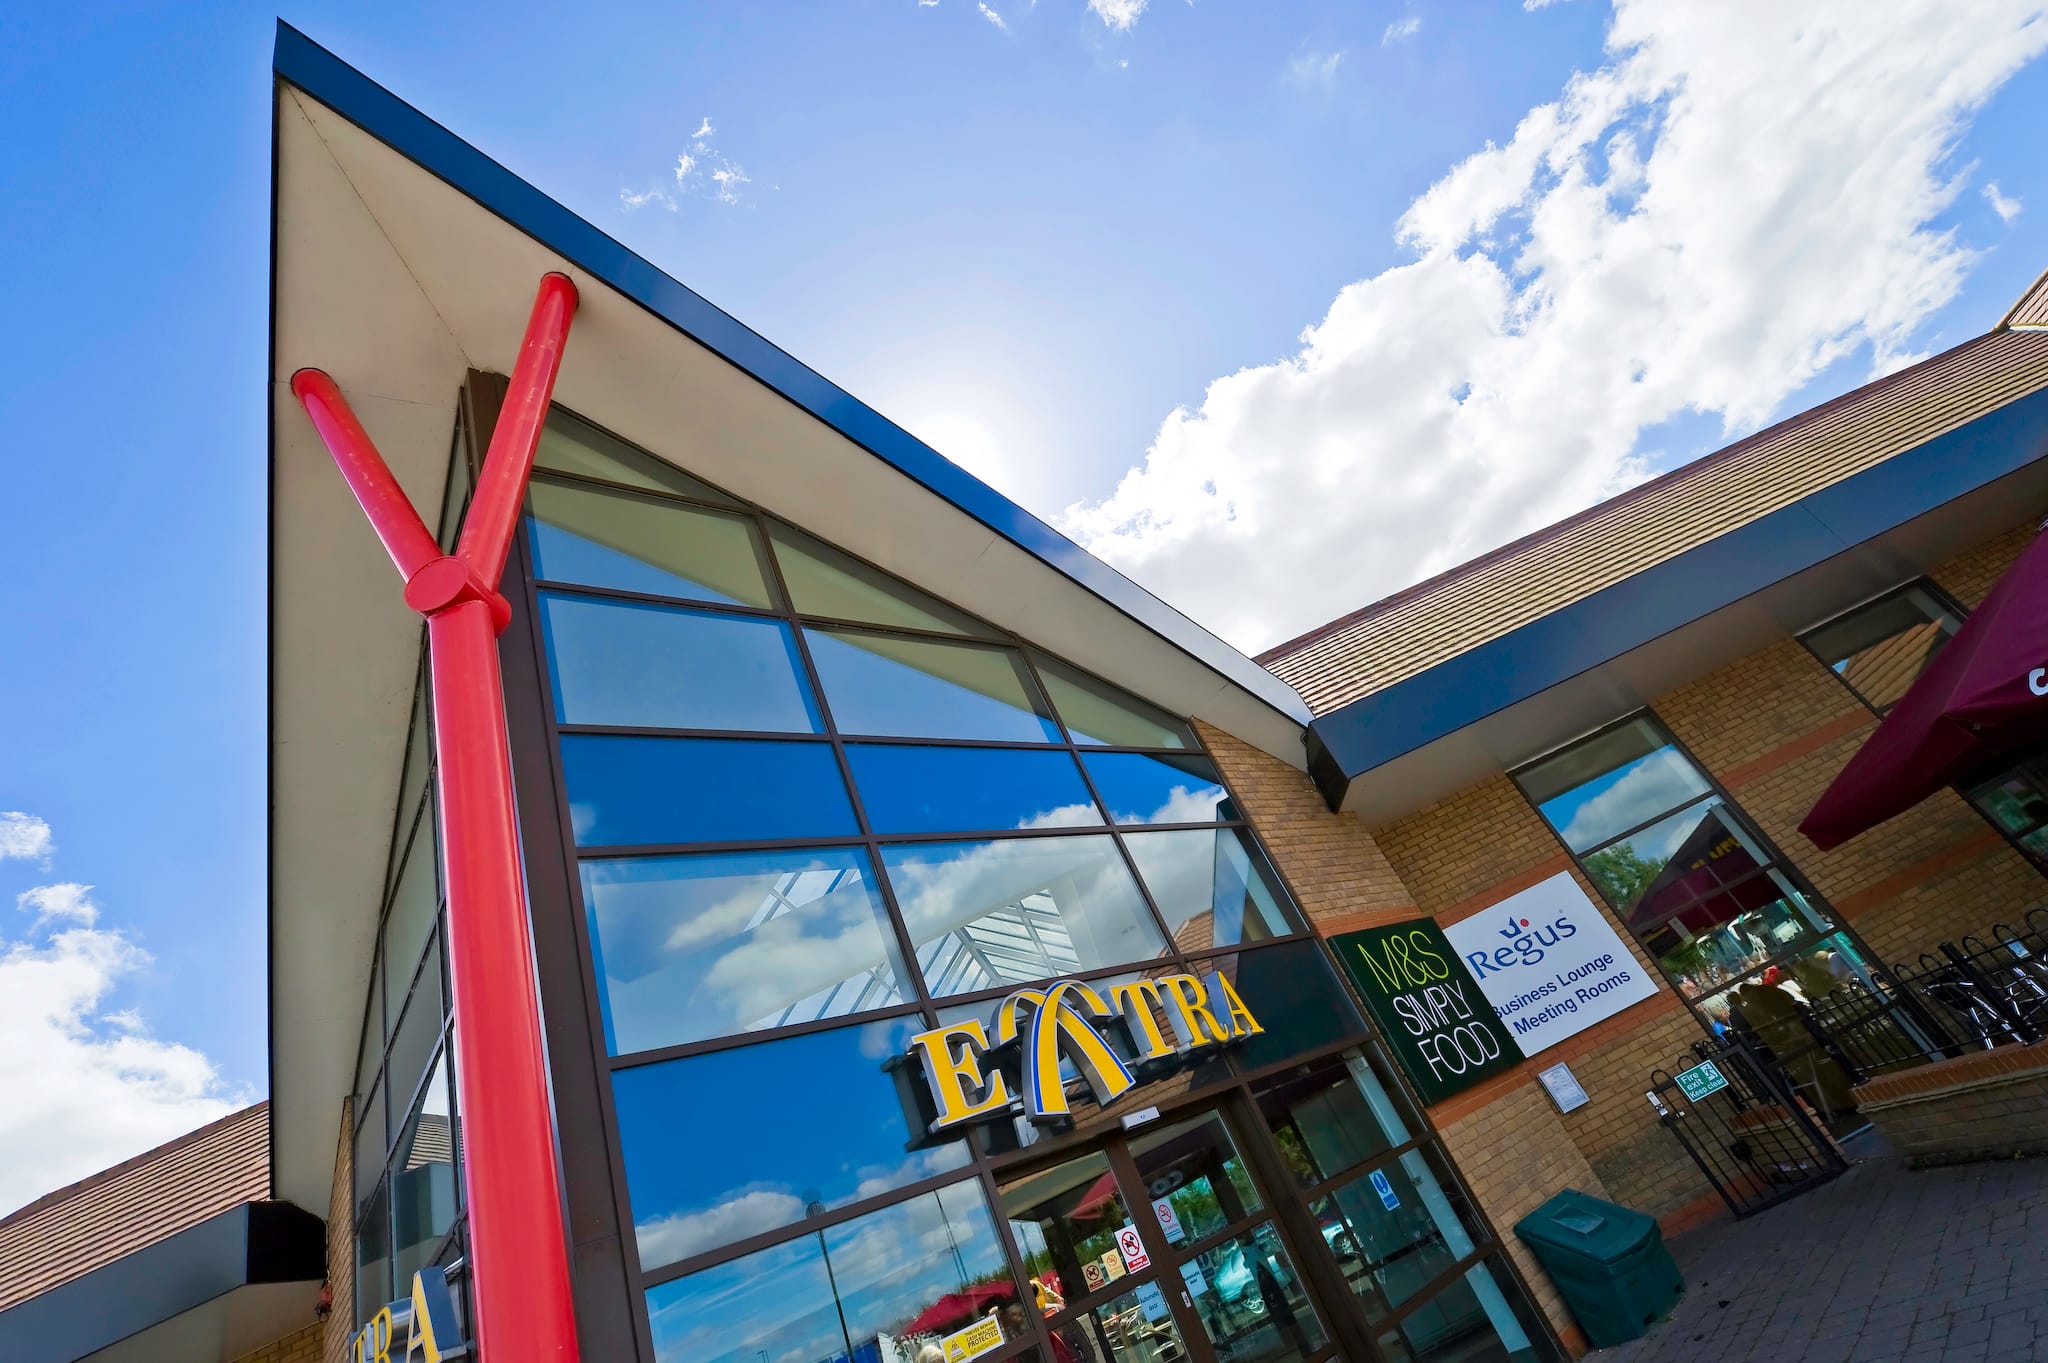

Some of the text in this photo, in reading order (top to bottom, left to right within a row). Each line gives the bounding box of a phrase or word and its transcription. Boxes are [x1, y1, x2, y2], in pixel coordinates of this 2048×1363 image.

[1357, 930, 1449, 994] M&S
[1466, 917, 1577, 979] Regus
[1556, 954, 1614, 987] Lounge
[1393, 980, 1473, 1036] SIMPLY
[1513, 971, 1631, 1035] Meeting Rooms
[912, 970, 1264, 1131] EXTRA
[1417, 1021, 1500, 1082] FOOD
[1680, 1072, 1699, 1085] Fire
[1686, 1078, 1704, 1091] exit
[1689, 1078, 1724, 1099] Keep clear
[967, 1330, 999, 1349] PROTECTED
